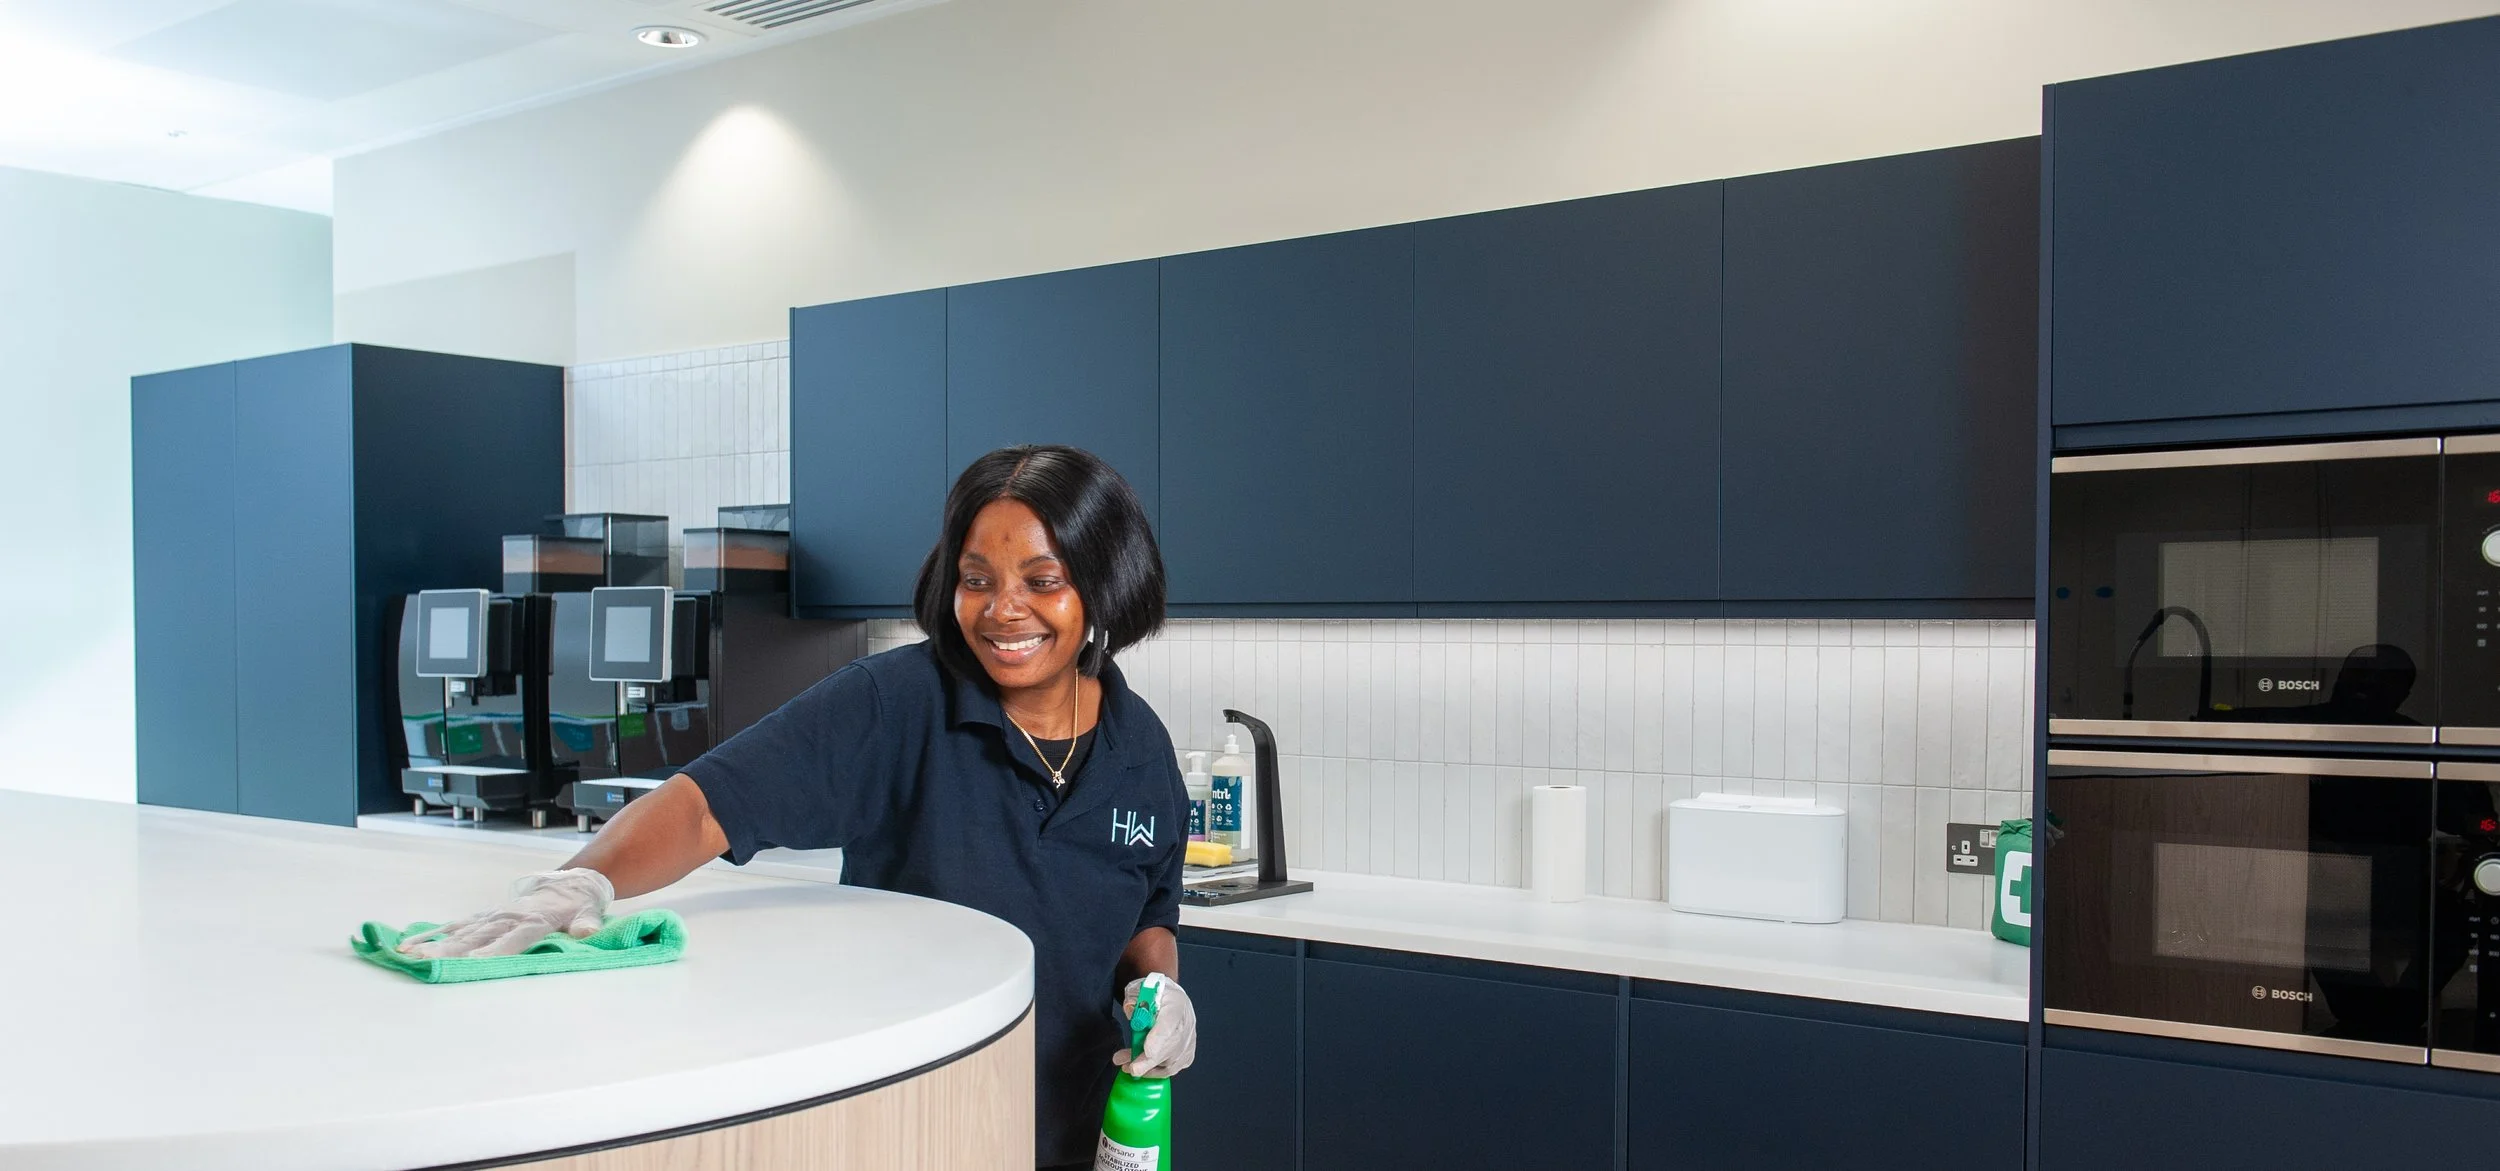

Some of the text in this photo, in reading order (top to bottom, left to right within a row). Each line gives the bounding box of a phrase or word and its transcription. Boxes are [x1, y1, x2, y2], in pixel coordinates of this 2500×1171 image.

[2278, 680, 2320, 690] BOSCH
[1111, 808, 1155, 847] HW
[2271, 989, 2313, 1002] BOSCH
[1108, 1144, 1135, 1158] tersano
[1104, 1153, 1139, 1168] STABILIZED
